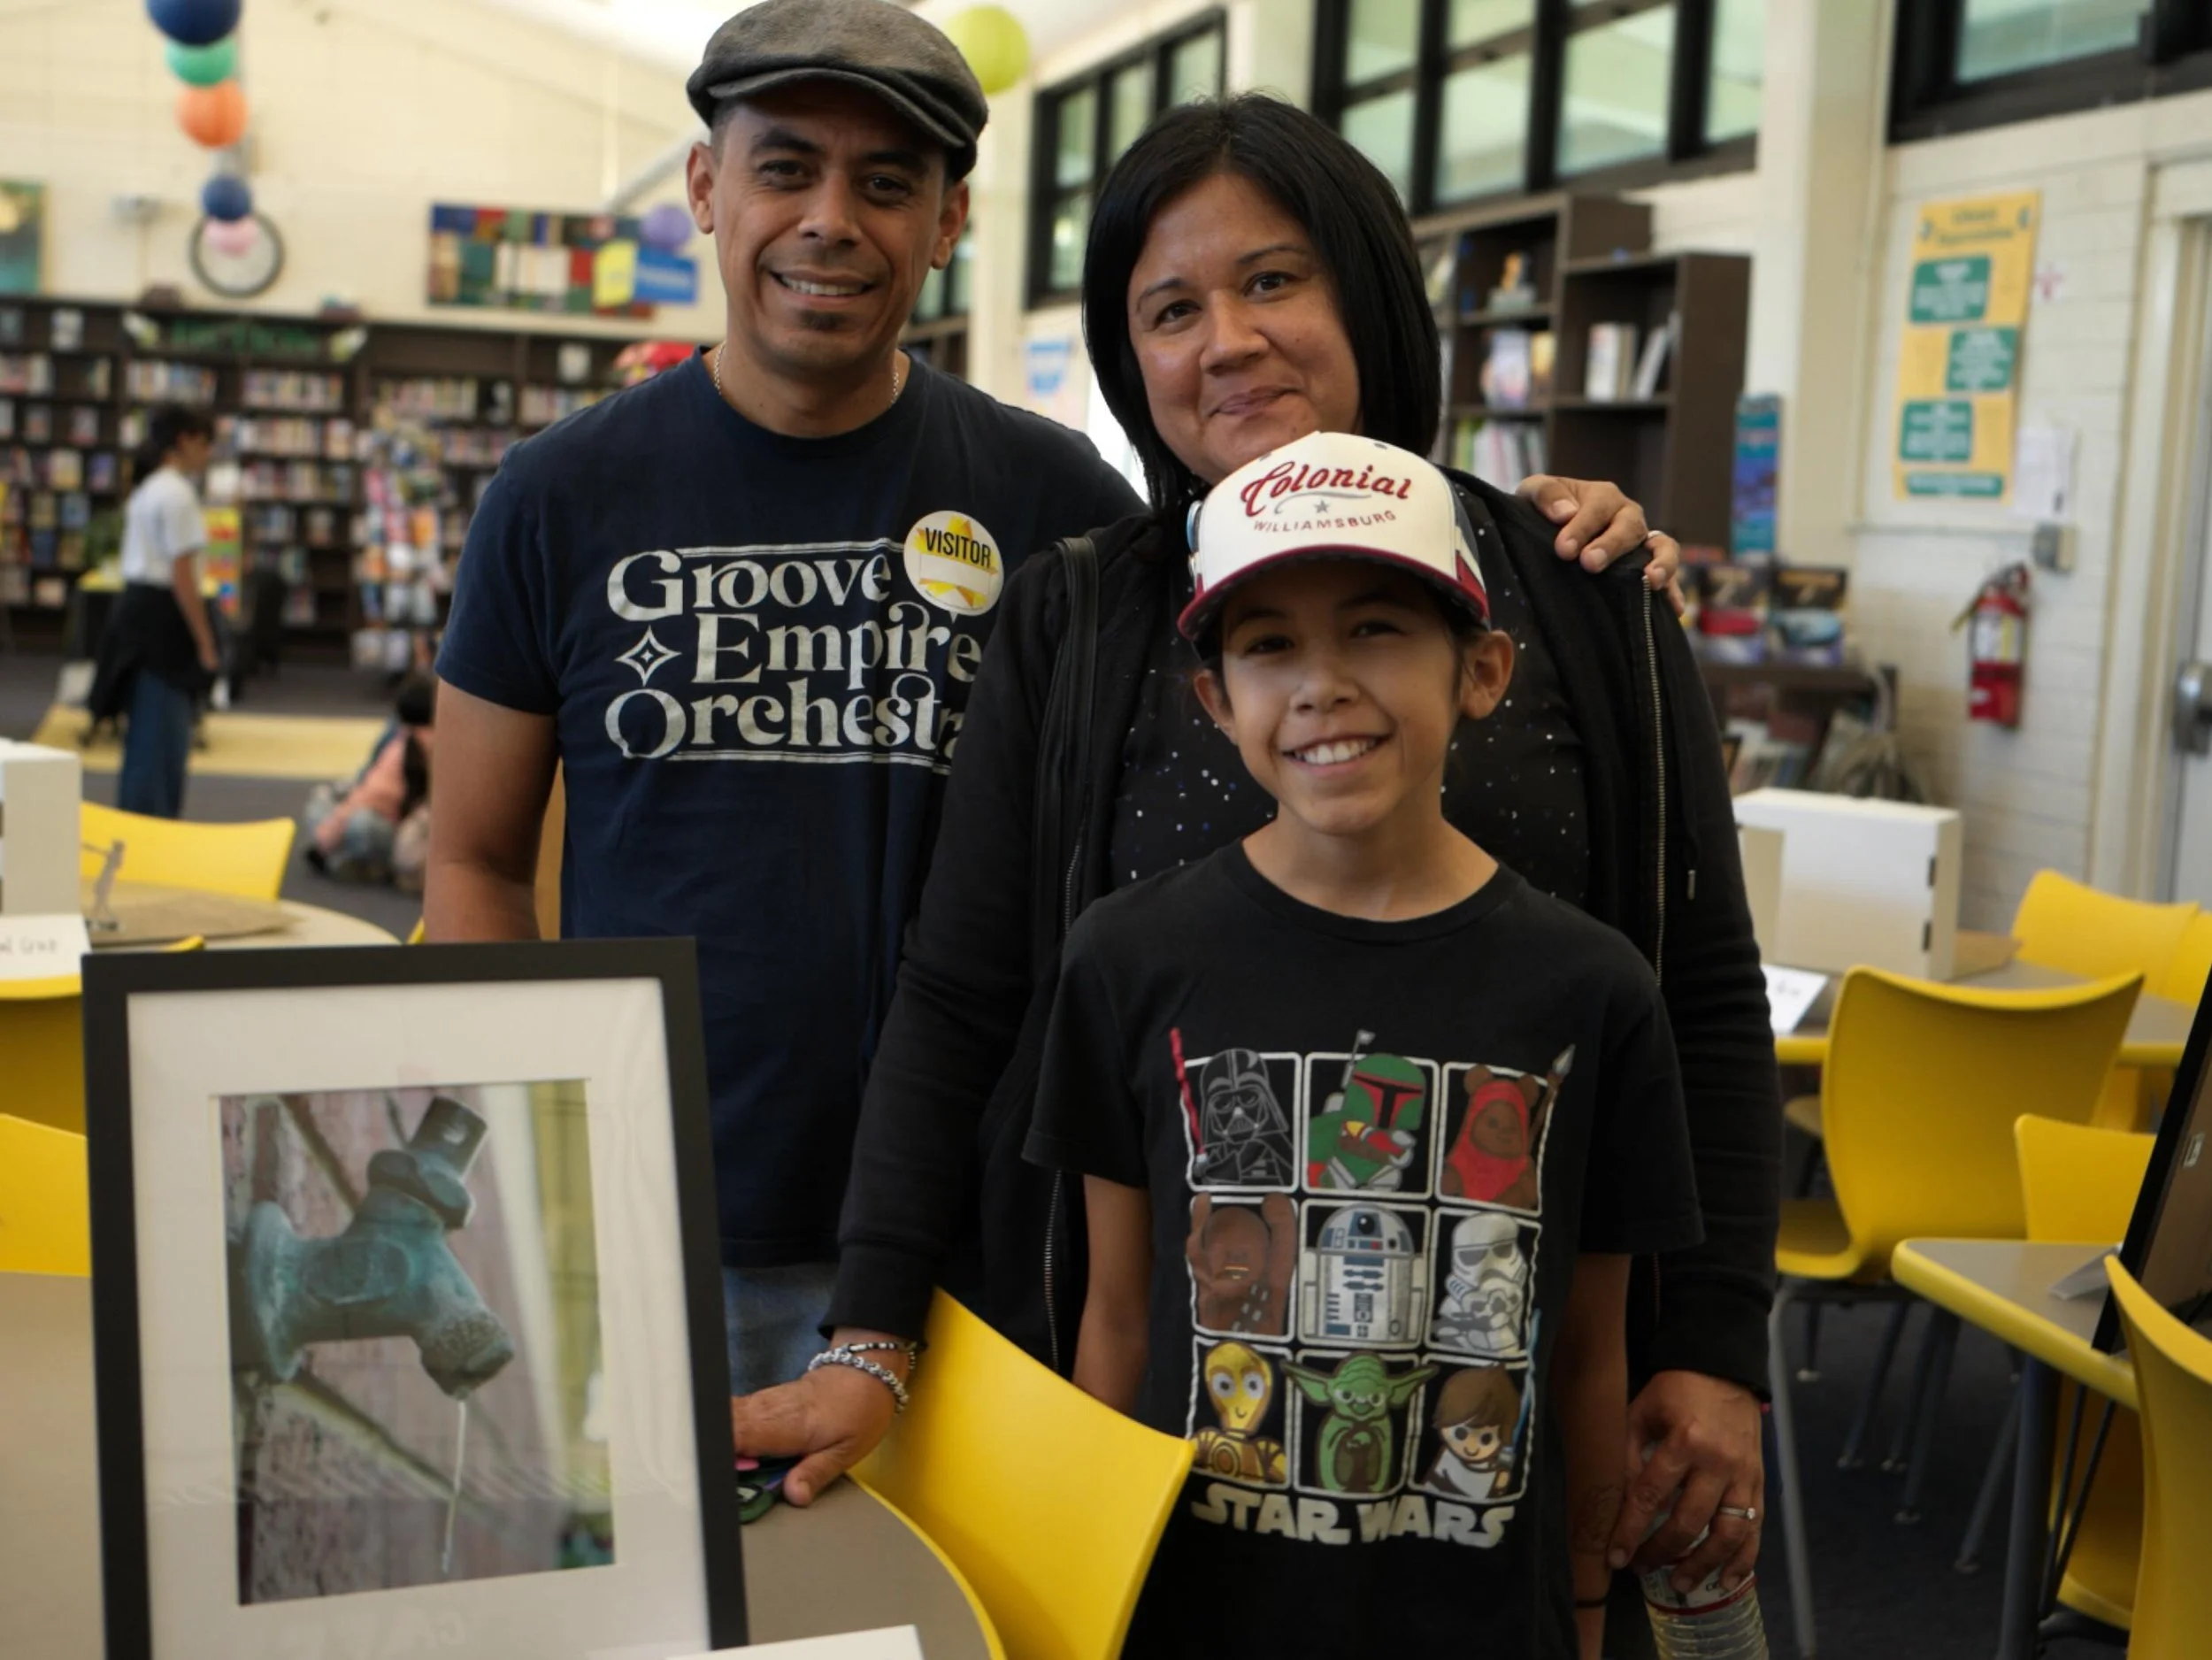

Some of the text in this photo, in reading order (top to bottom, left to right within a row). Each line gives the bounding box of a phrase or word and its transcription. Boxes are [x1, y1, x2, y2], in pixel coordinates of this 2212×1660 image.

[1240, 461, 1411, 517] Colonial
[926, 527, 991, 568] VISITOR
[1254, 510, 1396, 532] WILLIAMSBURG
[607, 550, 892, 621] Groove
[691, 602, 982, 690] Empire
[1191, 1481, 1515, 1549] STAR WARS
